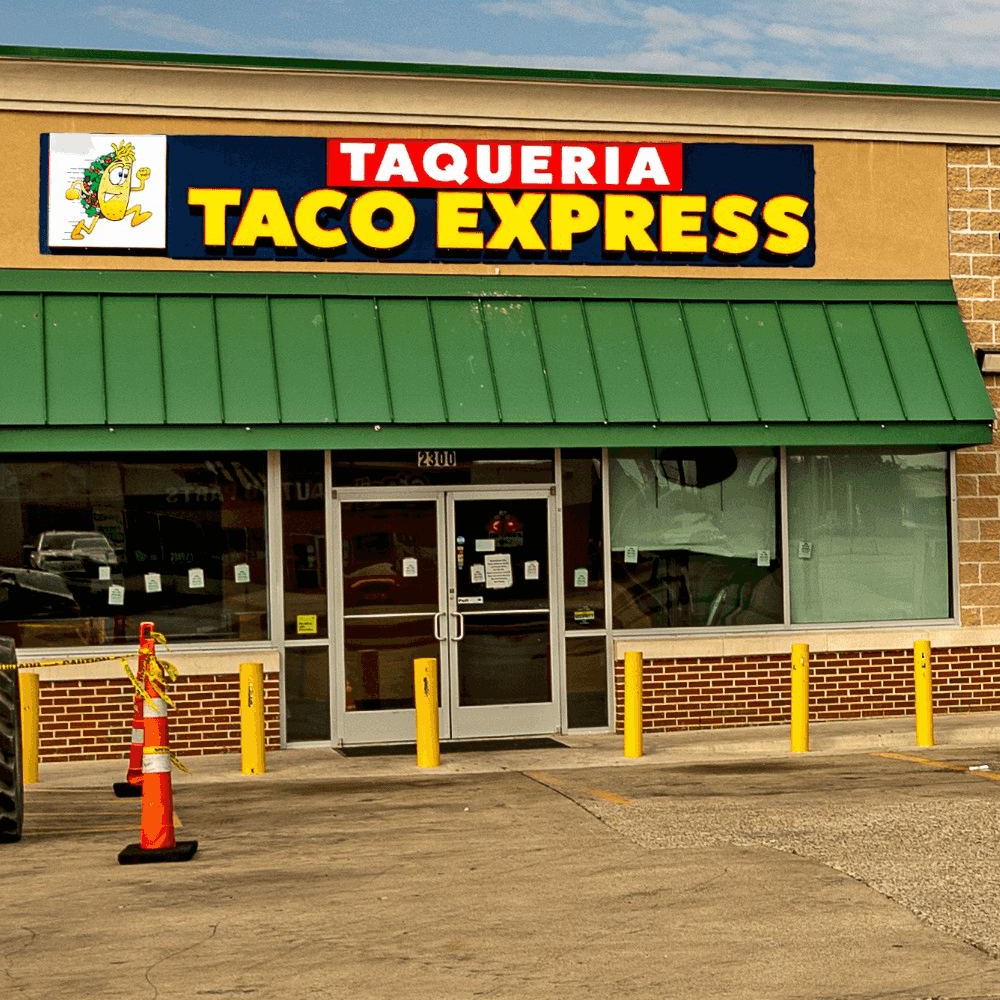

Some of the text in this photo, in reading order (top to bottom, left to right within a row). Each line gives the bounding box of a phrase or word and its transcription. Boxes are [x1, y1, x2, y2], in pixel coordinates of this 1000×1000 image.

[340, 142, 670, 186] TAQUERIA
[188, 188, 810, 256] TACO EXPRESS
[418, 451, 456, 467] 2300
